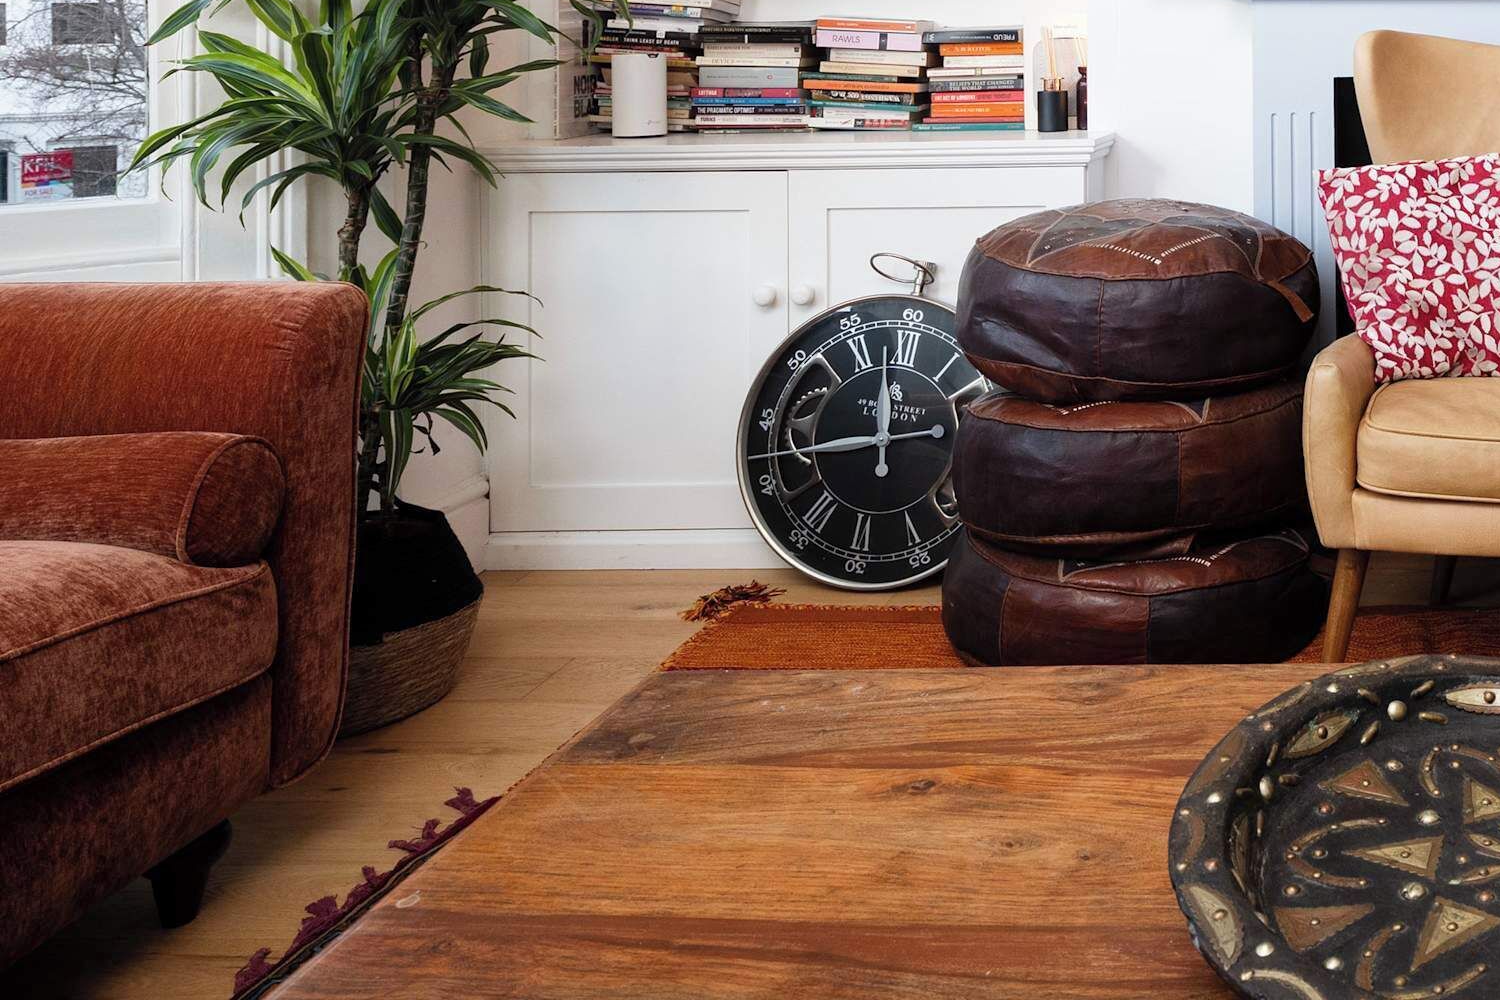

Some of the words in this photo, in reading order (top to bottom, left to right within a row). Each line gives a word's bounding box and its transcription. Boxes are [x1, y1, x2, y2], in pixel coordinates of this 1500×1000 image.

[832, 35, 861, 43] RAWLS
[993, 33, 1016, 41] FREUD
[839, 314, 862, 331] 55
[902, 308, 924, 324] 60
[847, 334, 874, 374] XI
[890, 330, 921, 368] XII
[787, 350, 808, 372] 50
[933, 352, 960, 384] I
[759, 408, 775, 433] 45
[863, 407, 918, 422] LODON
[893, 404, 926, 416] STREET
[759, 474, 776, 497] 40
[802, 490, 839, 534] VII
[788, 528, 810, 551] 35
[851, 512, 872, 552] VI
[904, 510, 921, 547] V
[845, 560, 867, 575] 30
[909, 551, 932, 568] 25
